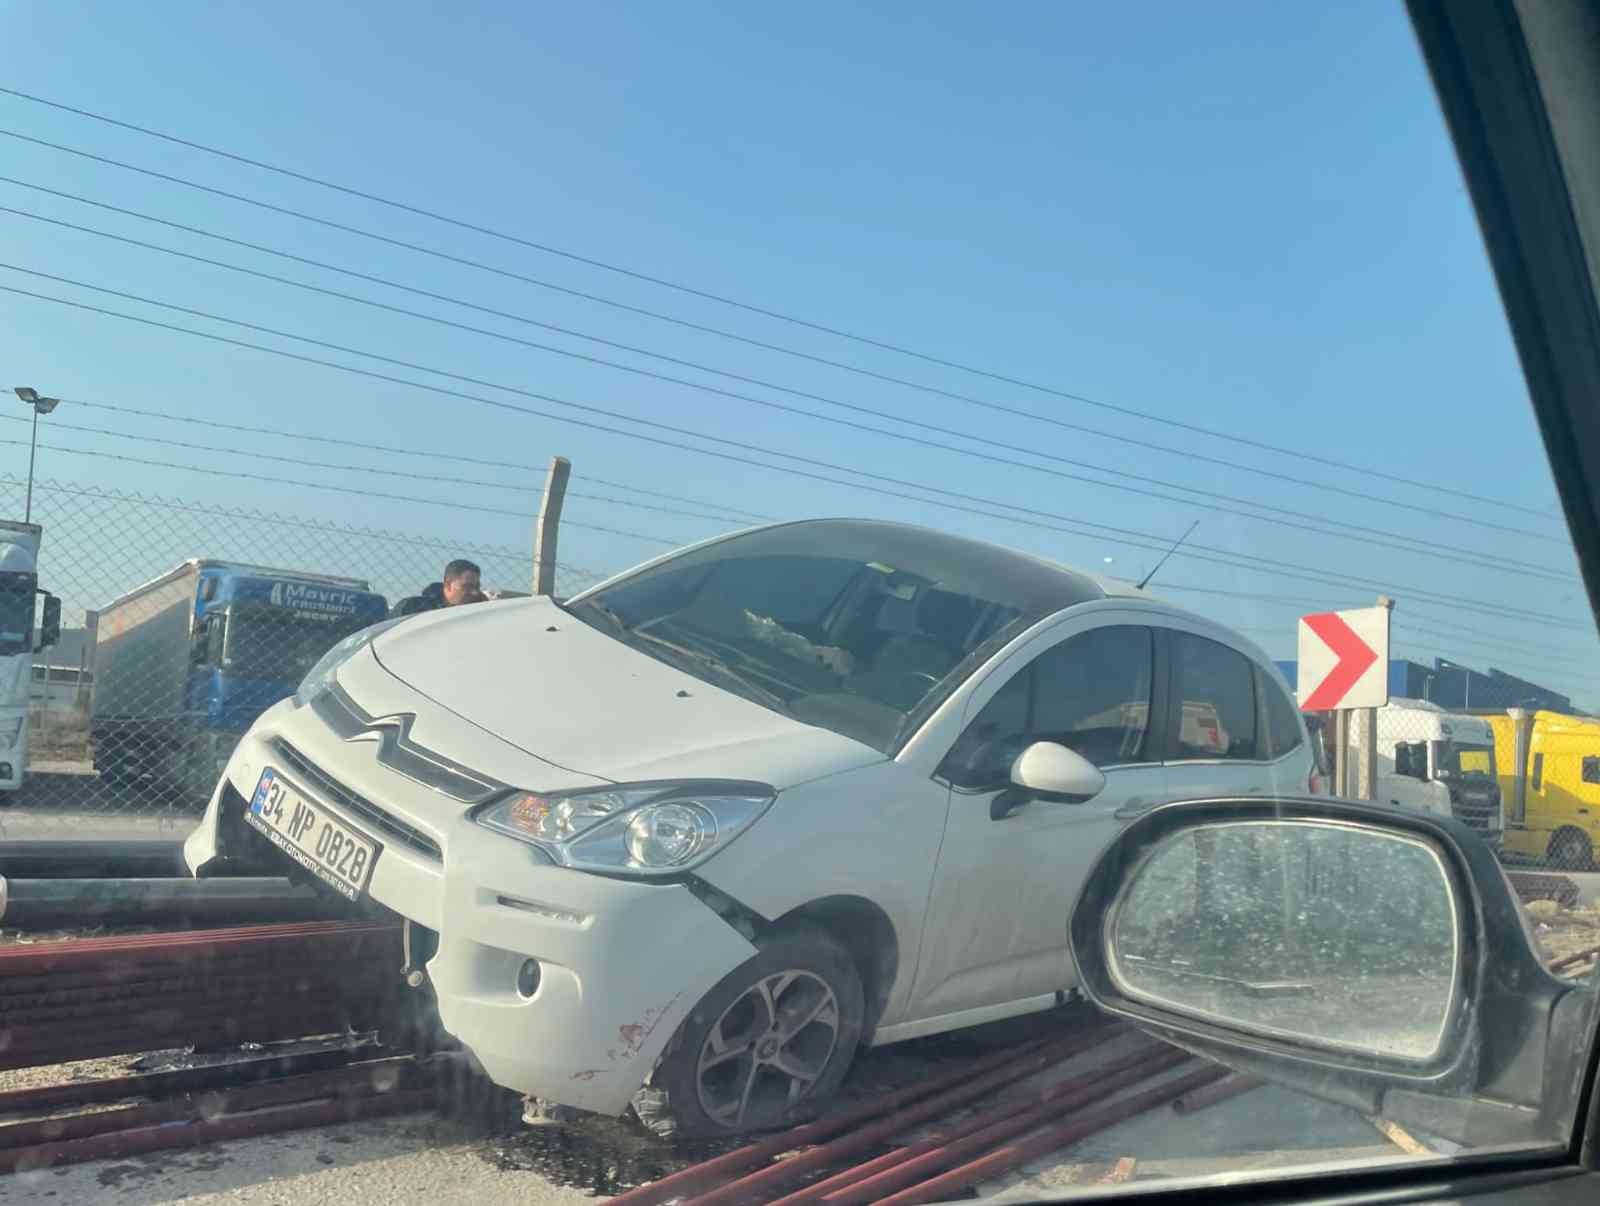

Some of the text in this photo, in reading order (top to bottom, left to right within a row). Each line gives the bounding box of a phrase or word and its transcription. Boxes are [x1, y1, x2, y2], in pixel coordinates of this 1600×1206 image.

[263, 783, 287, 825] 34
[288, 800, 316, 842] NP
[316, 823, 368, 883] 0828
